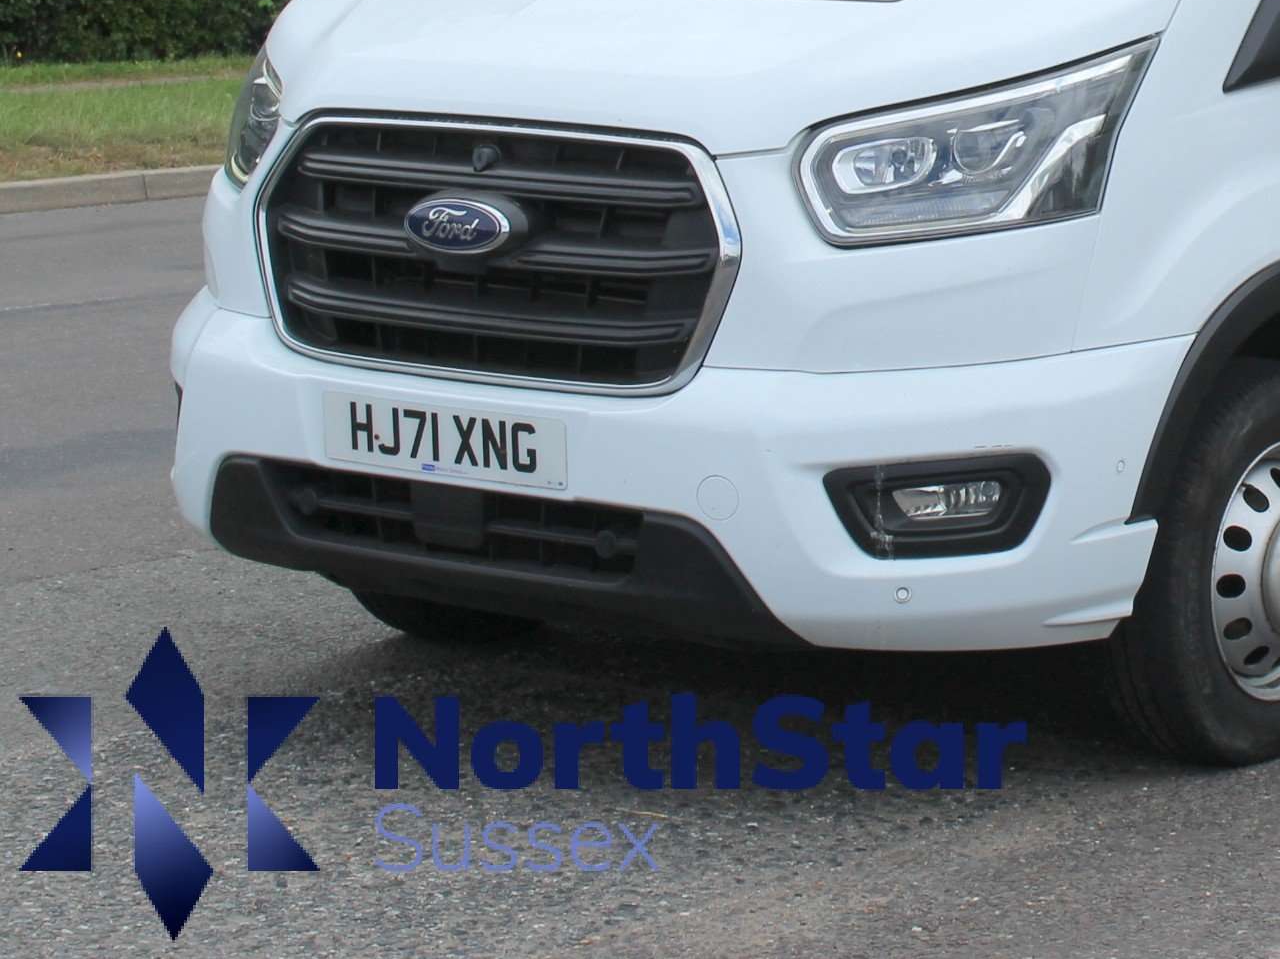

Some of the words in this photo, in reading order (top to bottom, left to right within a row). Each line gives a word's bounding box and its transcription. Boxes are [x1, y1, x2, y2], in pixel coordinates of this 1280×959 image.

[421, 207, 480, 240] Ford
[350, 401, 440, 462] HJ71
[452, 414, 537, 474] XNG
